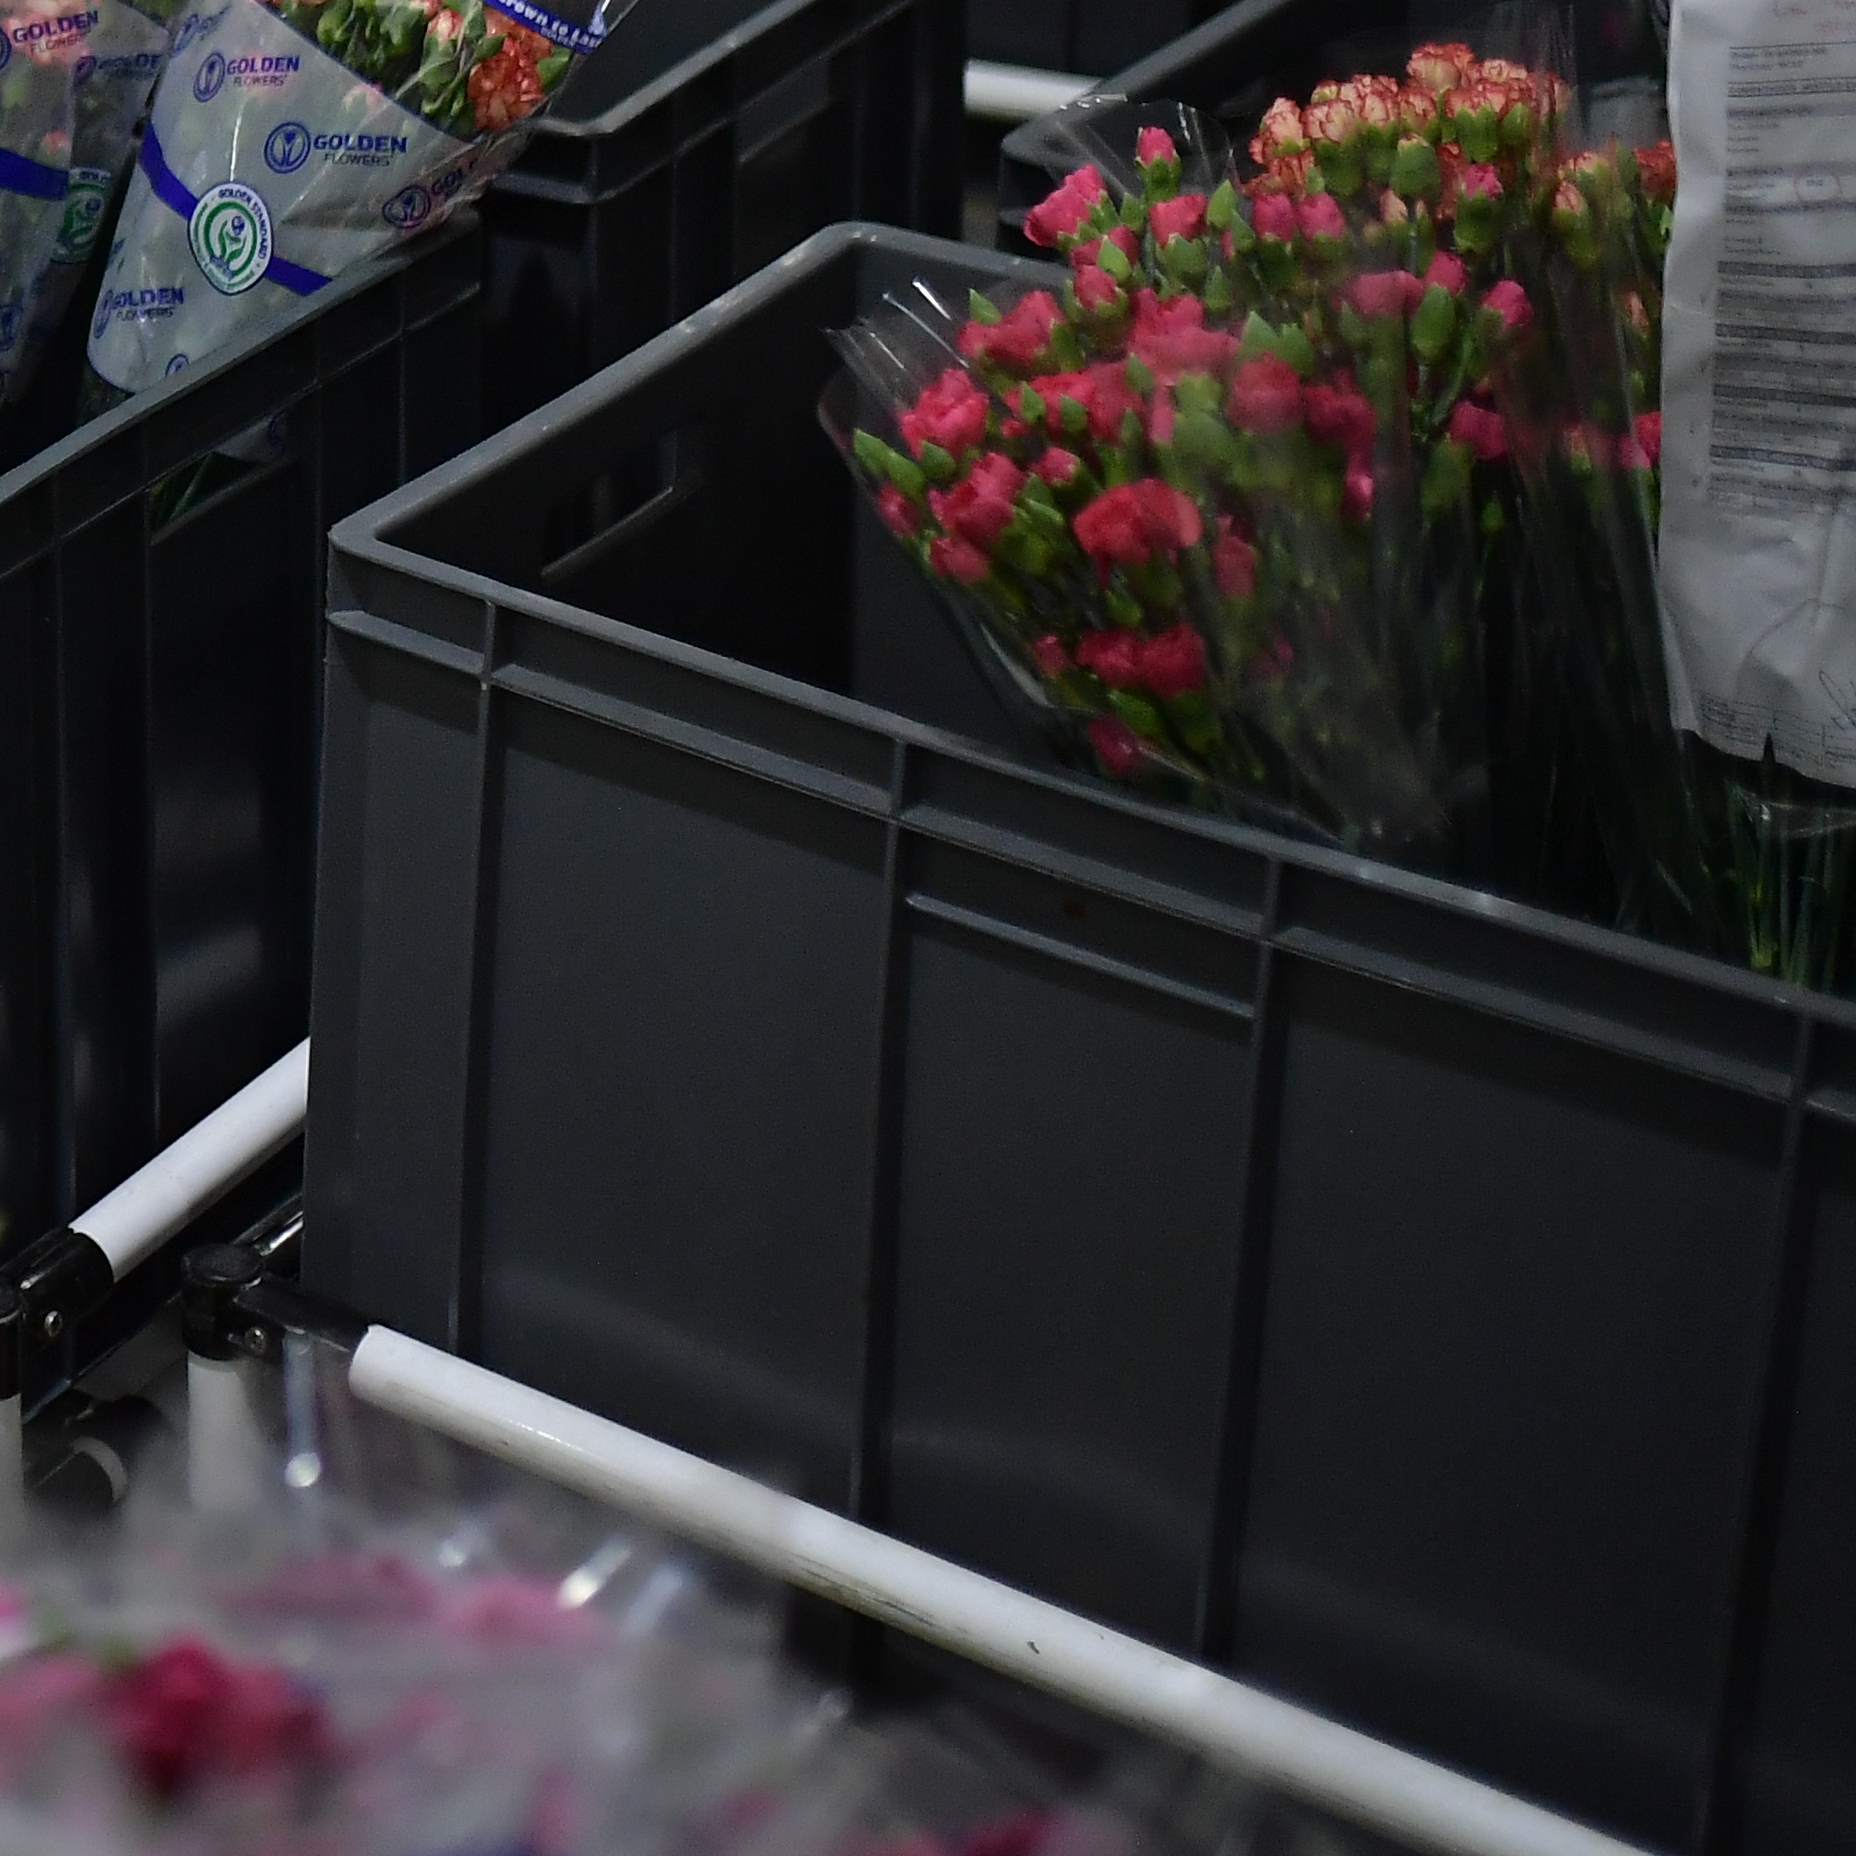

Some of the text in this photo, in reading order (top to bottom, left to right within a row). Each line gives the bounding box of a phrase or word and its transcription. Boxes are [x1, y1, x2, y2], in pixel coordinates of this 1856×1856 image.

[13, 10, 99, 43] GOLDEN
[551, 18, 569, 37] to
[227, 55, 300, 75] GOLDEN
[314, 133, 408, 154] GOLDEN
[324, 151, 394, 166] FLOWERS
